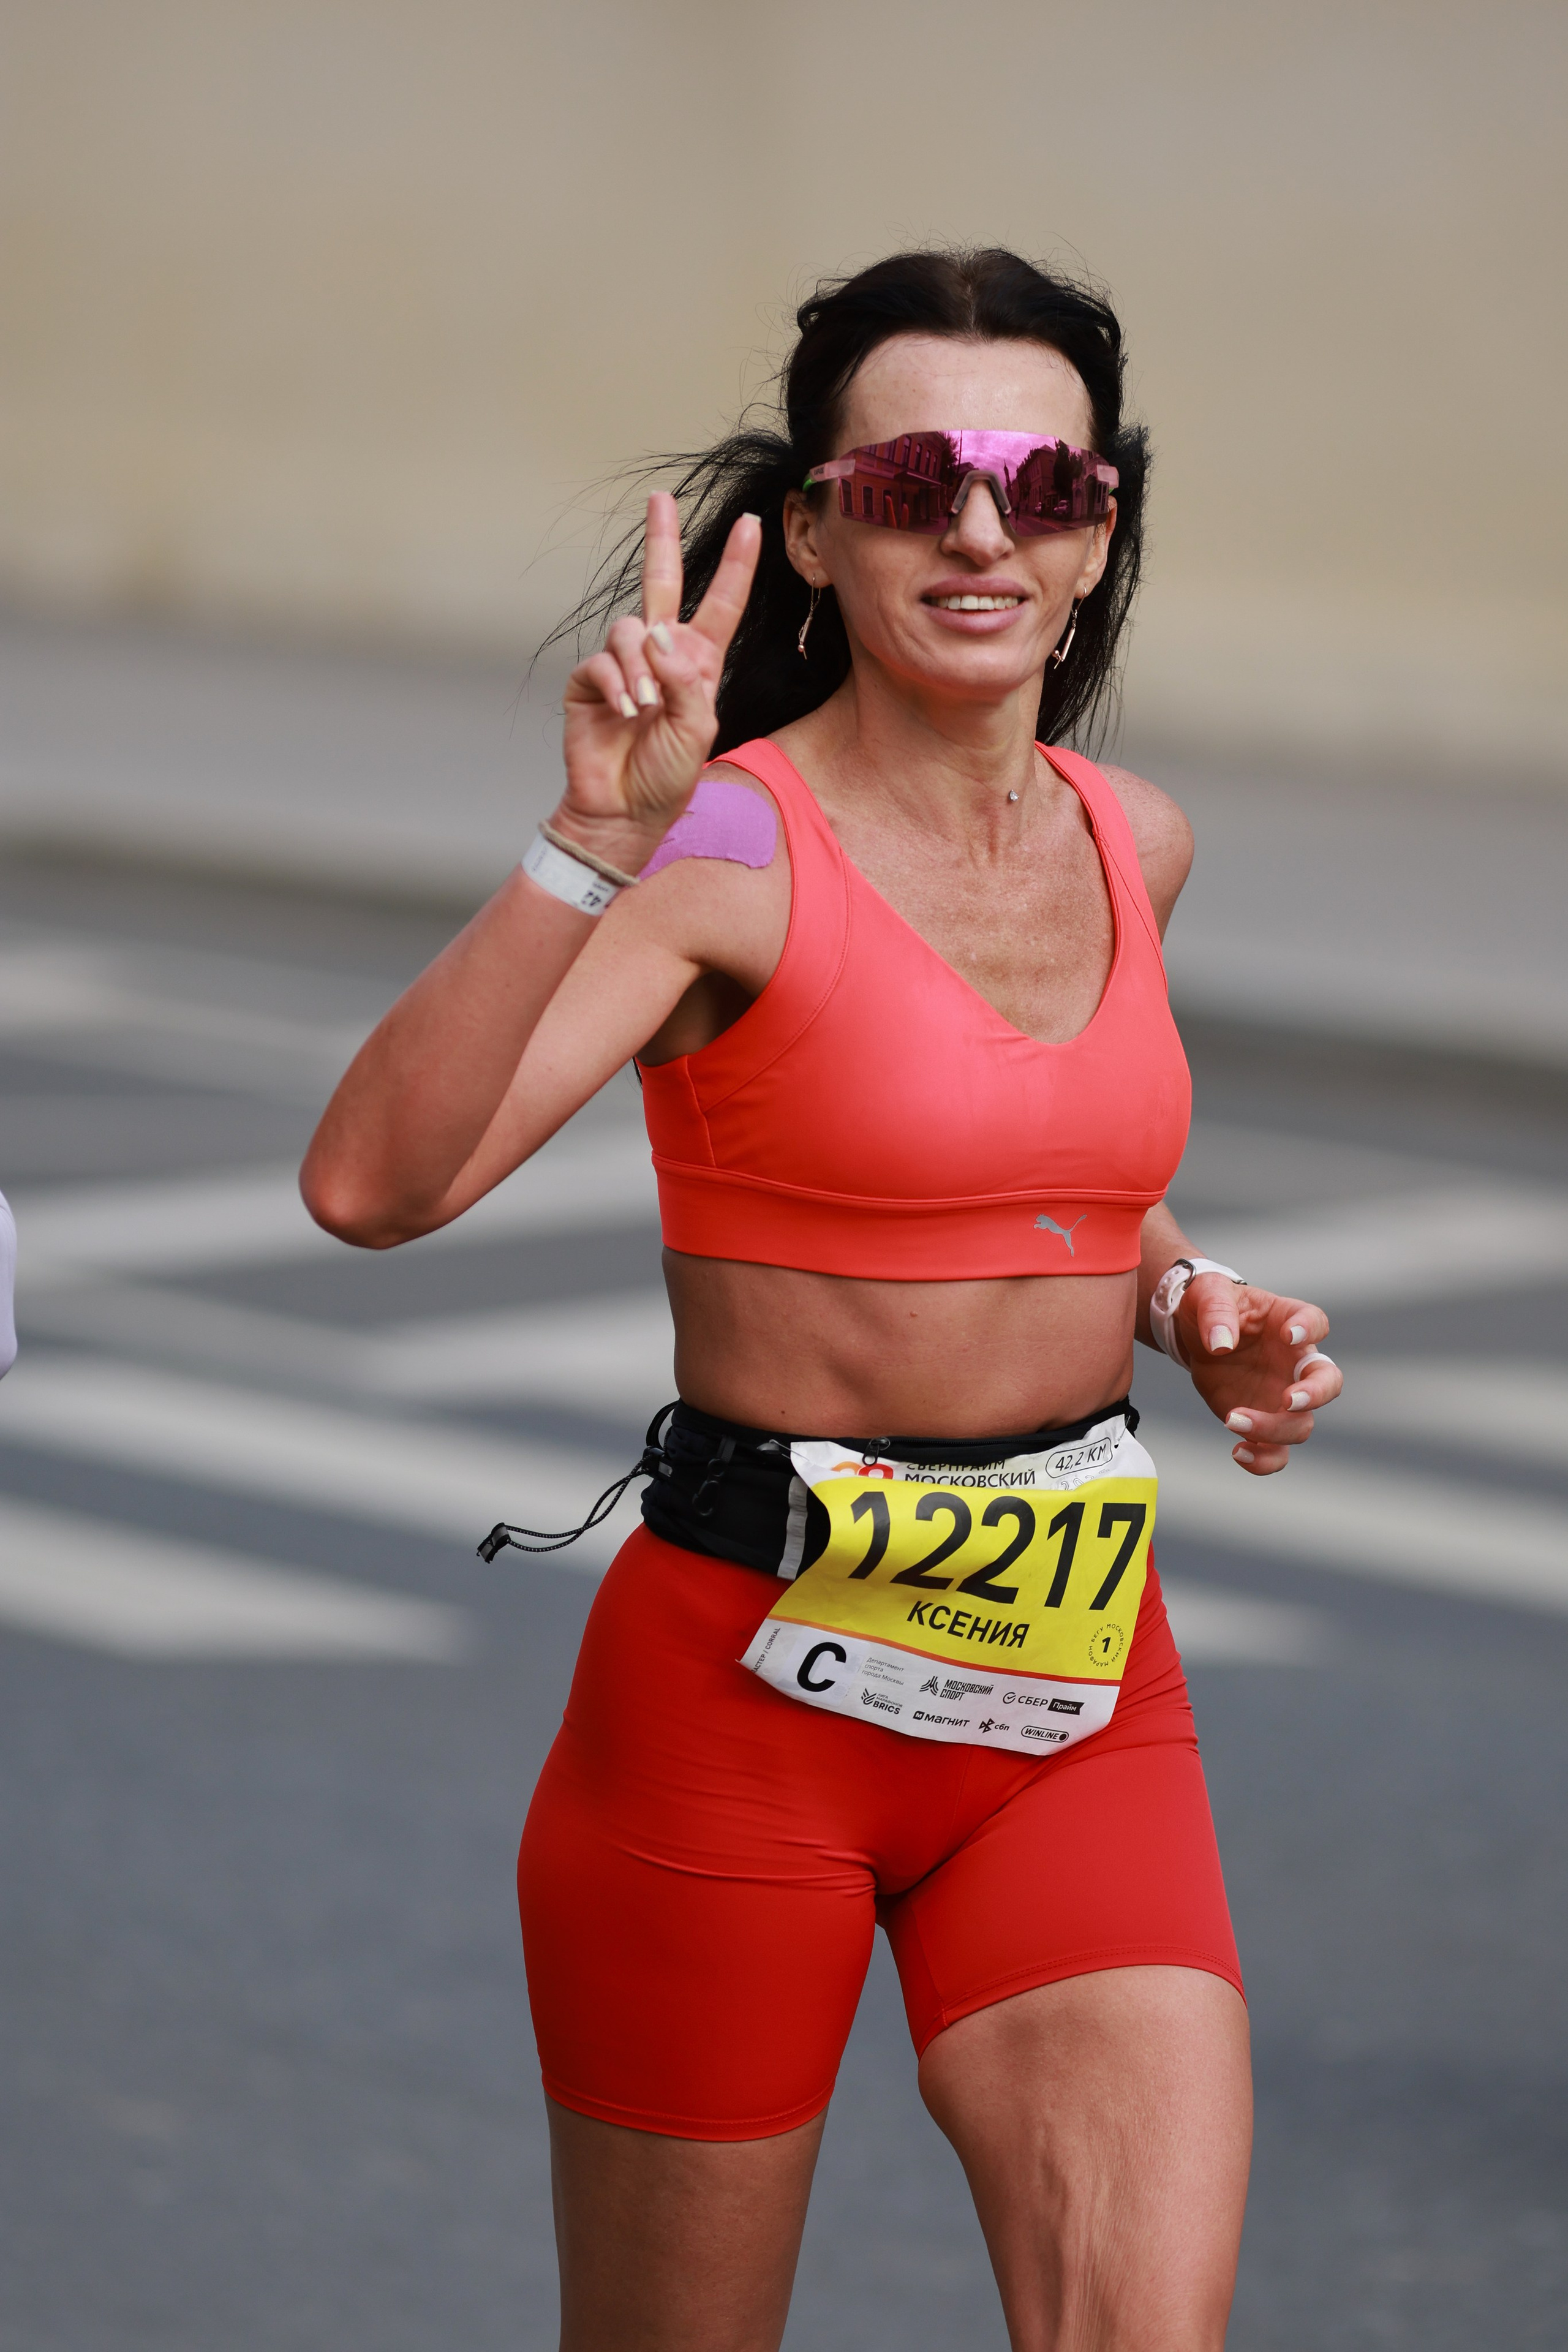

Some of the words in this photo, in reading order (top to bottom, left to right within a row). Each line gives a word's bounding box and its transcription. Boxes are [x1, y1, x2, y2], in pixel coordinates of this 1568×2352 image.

[1055, 1451, 1084, 1471] 42,2
[905, 1468, 1036, 1488] МОСКОВСКИЙ
[848, 1491, 1147, 1611] 12217
[907, 1600, 1030, 1649] КСЕНИЯ
[765, 1627, 781, 1649] CORRAL
[1102, 1637, 1111, 1653] 1
[797, 1642, 846, 1692] C
[864, 1664, 884, 1672] спорта
[867, 1657, 905, 1672] Департамент
[862, 1670, 881, 1678] города
[881, 1674, 904, 1686] Москвы
[940, 1689, 965, 1701] СПОРТ
[944, 1679, 994, 1695] МОСКОВСКИЙ
[873, 1700, 900, 1714] BRICS
[876, 1697, 903, 1708] МАРАФОНОВ
[1017, 1695, 1048, 1707] СБЕР
[1052, 1702, 1077, 1712] Прайм
[1025, 1727, 1060, 1740] WINLINE
